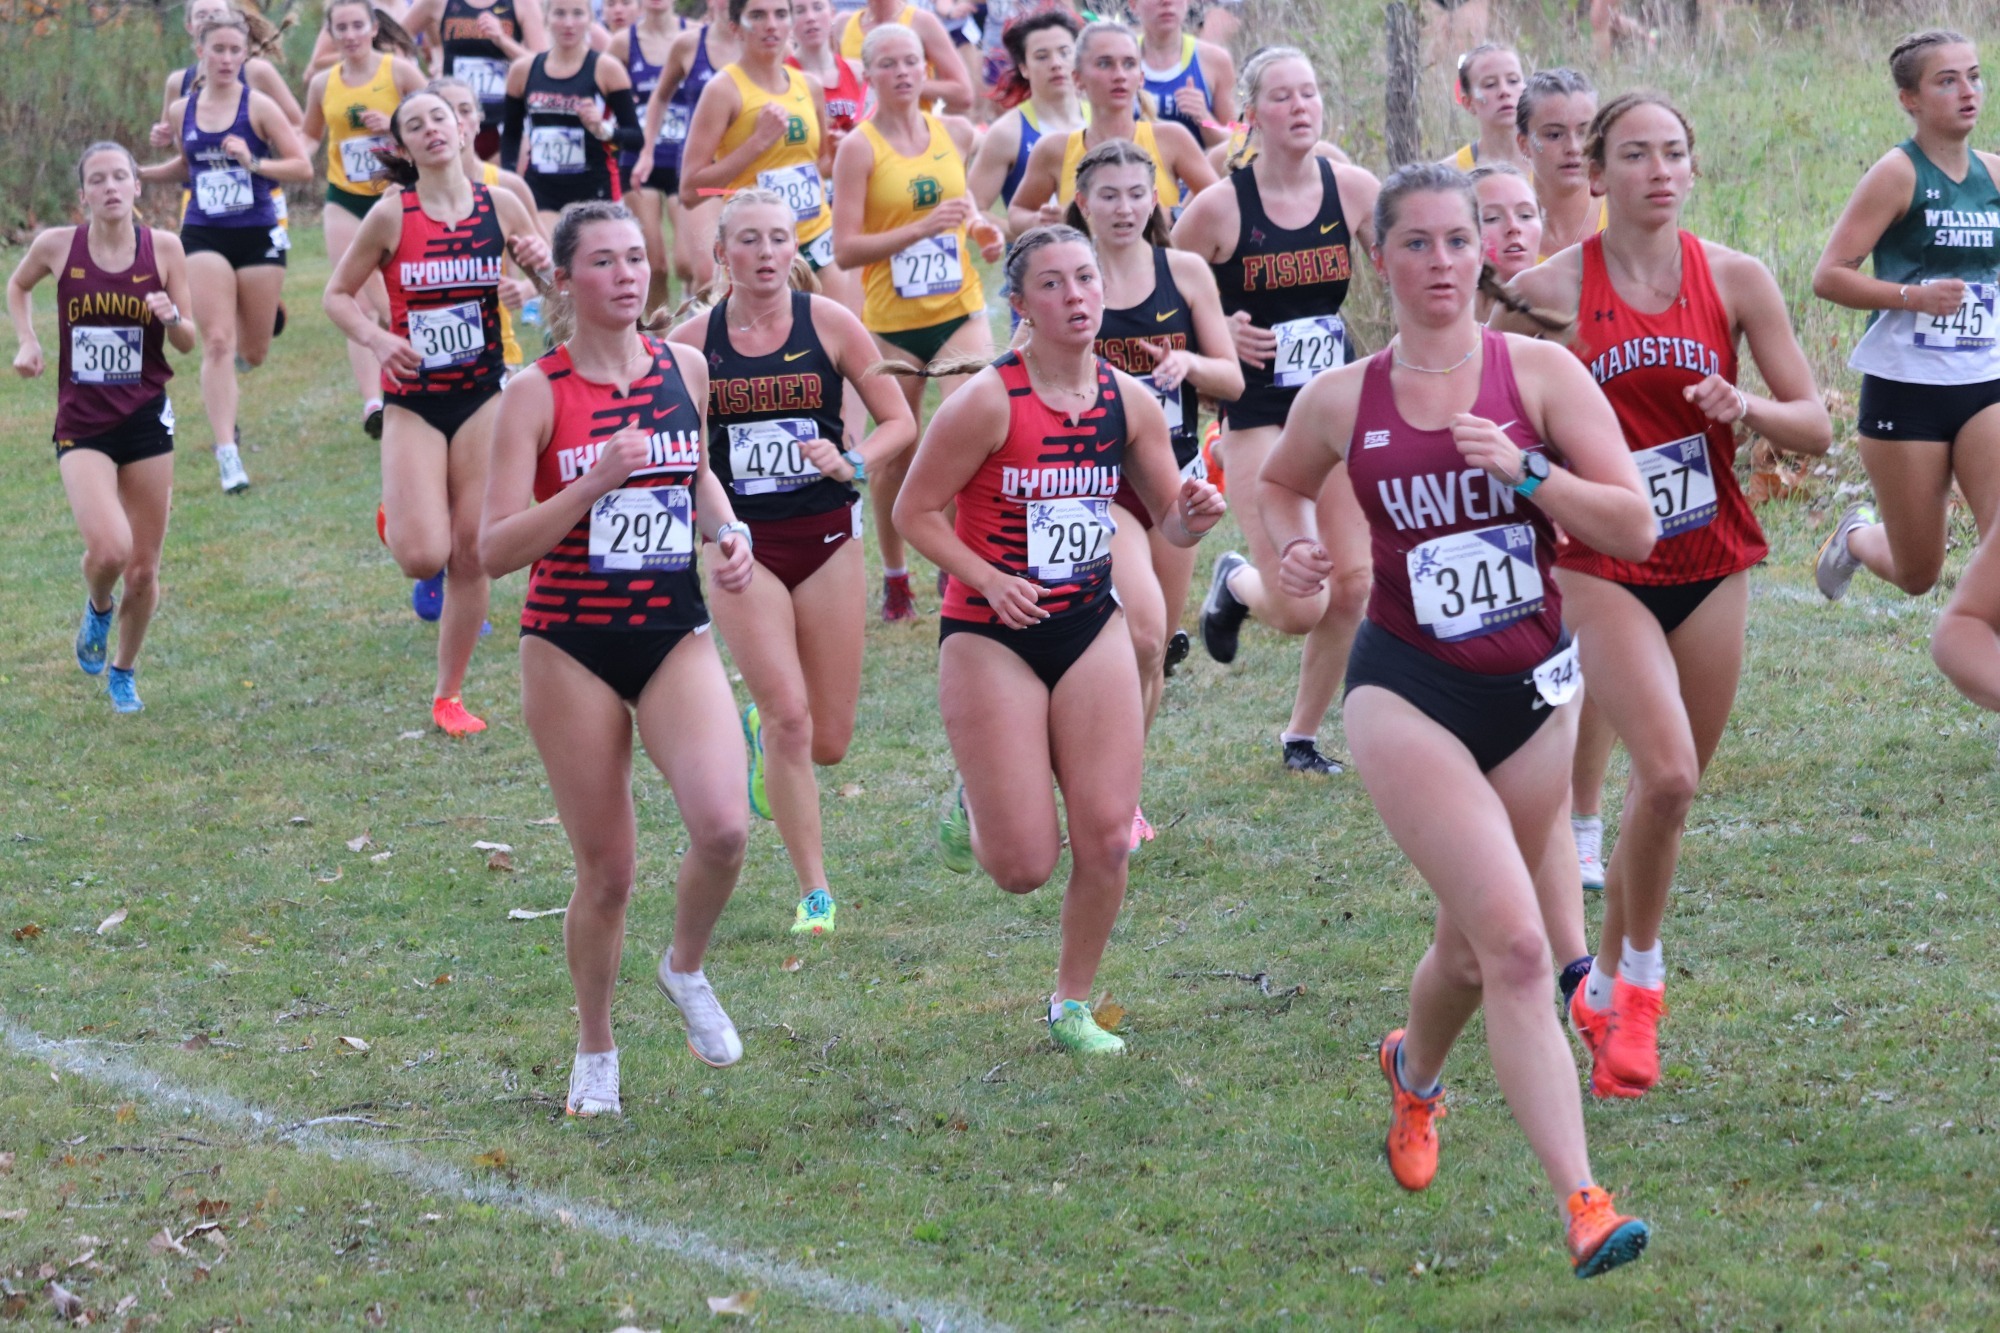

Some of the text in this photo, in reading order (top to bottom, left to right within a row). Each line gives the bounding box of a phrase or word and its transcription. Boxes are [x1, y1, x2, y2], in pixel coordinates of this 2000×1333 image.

[352, 151, 385, 173] 28
[207, 182, 243, 207] 322
[1924, 209, 2000, 228] WILLIAM
[1934, 229, 1994, 247] SMITH
[906, 252, 948, 285] 273
[1242, 244, 1352, 292] FISHER
[68, 292, 152, 326] GANNON
[1931, 302, 1985, 336] 445
[423, 322, 473, 356] 300
[1287, 335, 1335, 370] 423
[84, 344, 131, 372] 308
[1590, 336, 1719, 384] MANSFIELD
[746, 439, 804, 477] 420
[1377, 468, 1516, 531] HAVEN
[1648, 466, 1690, 518] 57
[609, 511, 674, 553] 292
[1048, 521, 1103, 564] 297
[1435, 555, 1523, 618] 341
[1549, 657, 1579, 696] 34
